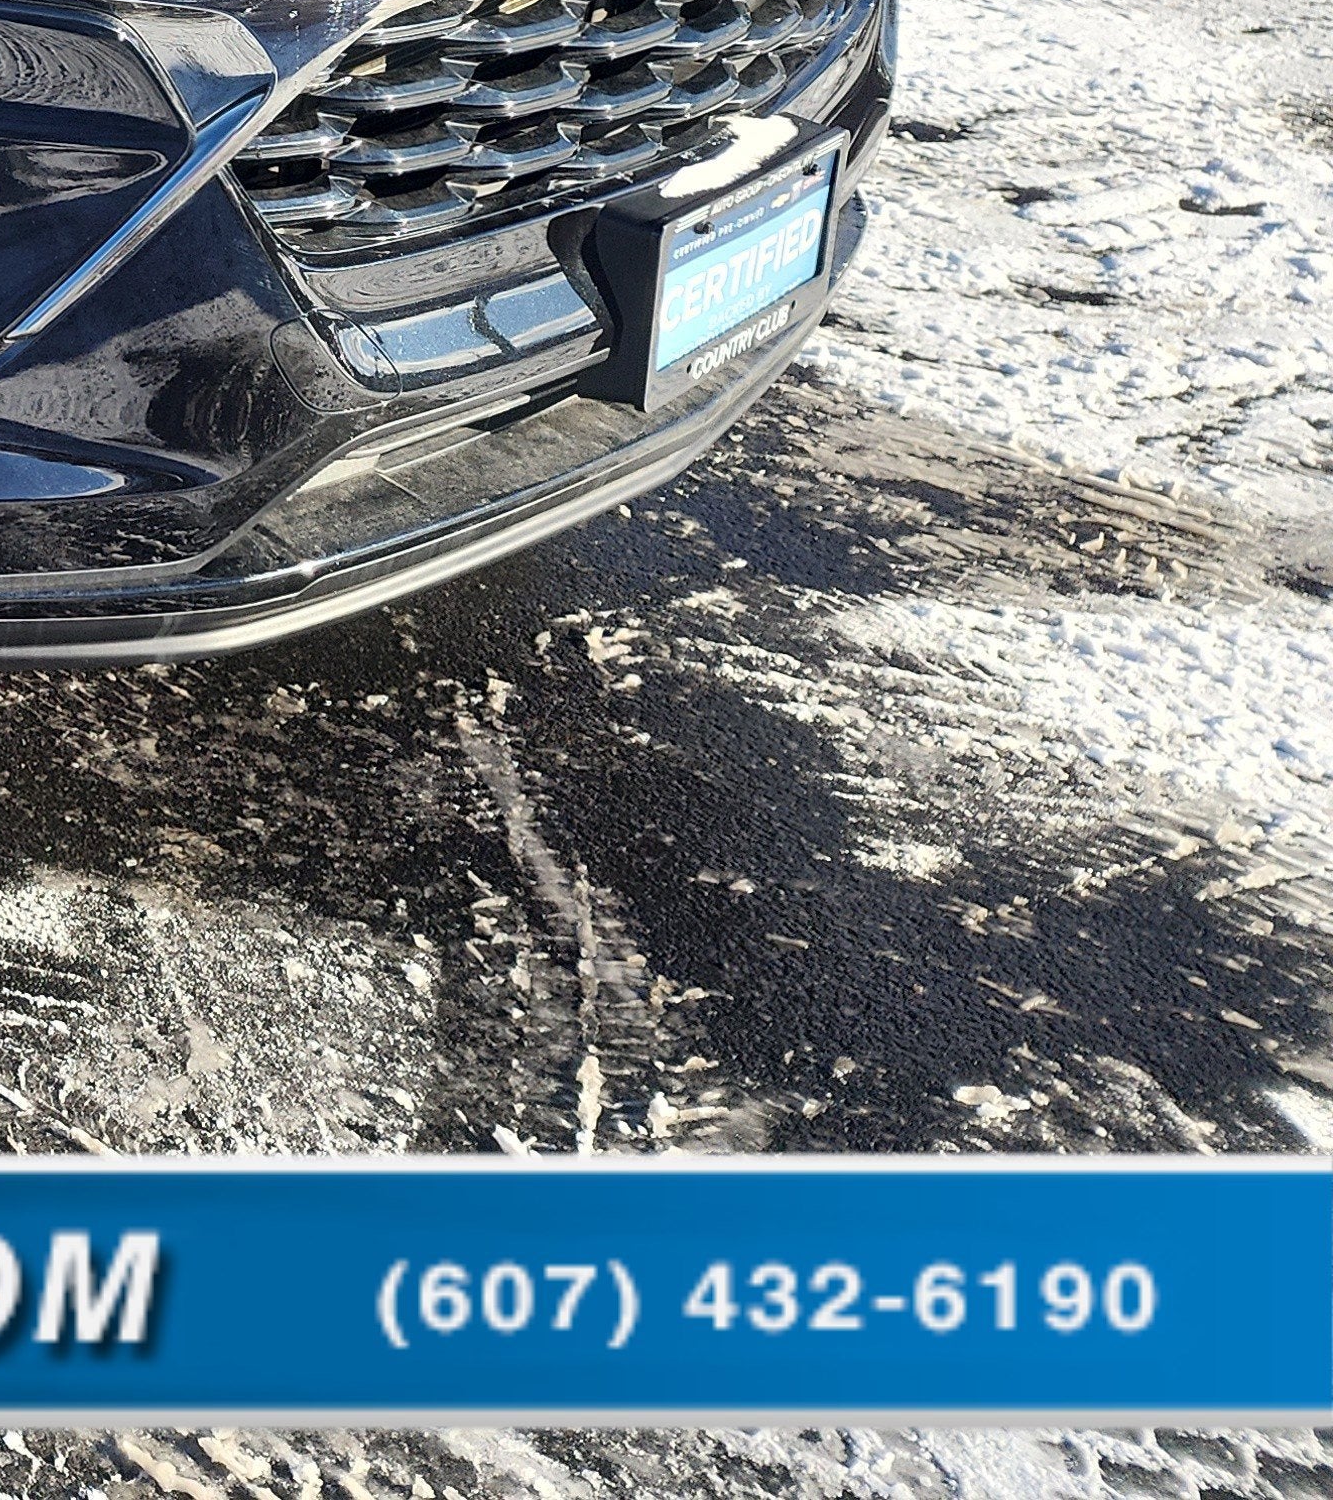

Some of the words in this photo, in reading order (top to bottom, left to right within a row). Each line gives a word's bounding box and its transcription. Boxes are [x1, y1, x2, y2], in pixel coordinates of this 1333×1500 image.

[659, 208, 822, 332] CERTIFIED
[690, 324, 757, 380] COUNTRY
[755, 304, 792, 342] CLUB
